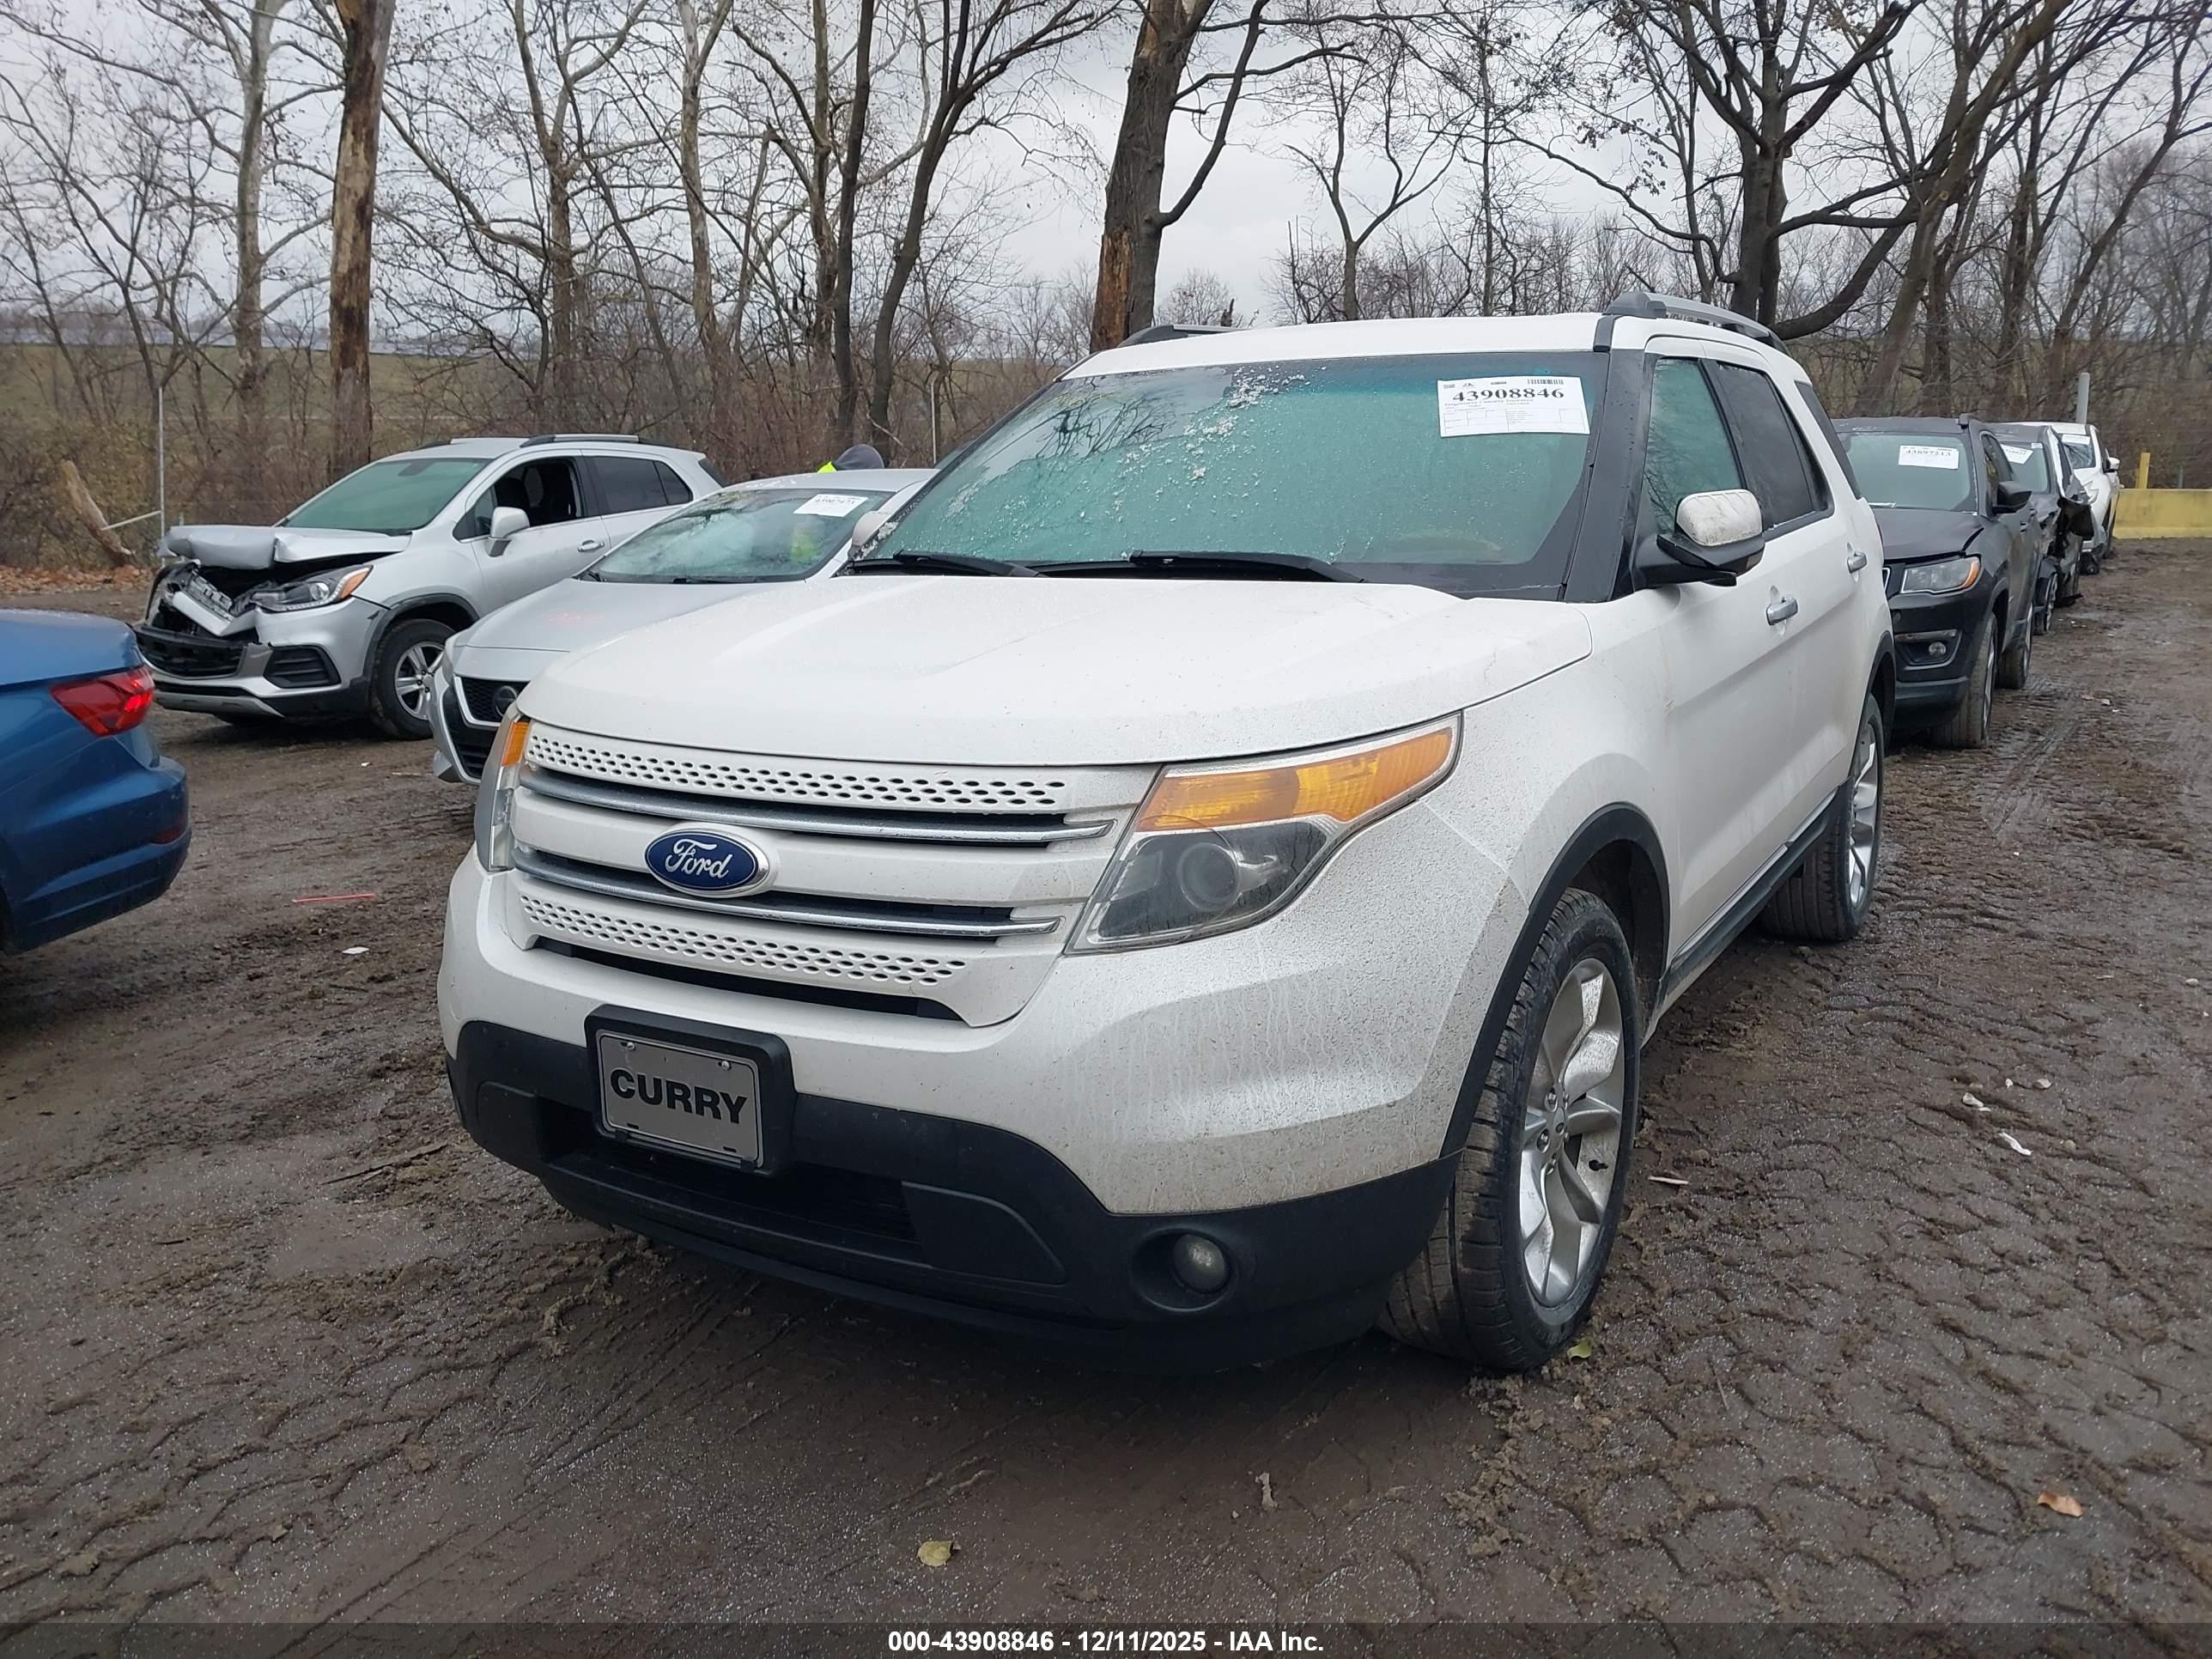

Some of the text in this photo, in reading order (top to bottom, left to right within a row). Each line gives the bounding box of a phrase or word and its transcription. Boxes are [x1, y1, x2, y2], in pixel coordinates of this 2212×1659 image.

[1453, 387, 1565, 401] 43908846
[665, 838, 733, 879] Ford
[611, 1068, 747, 1124] CURRY
